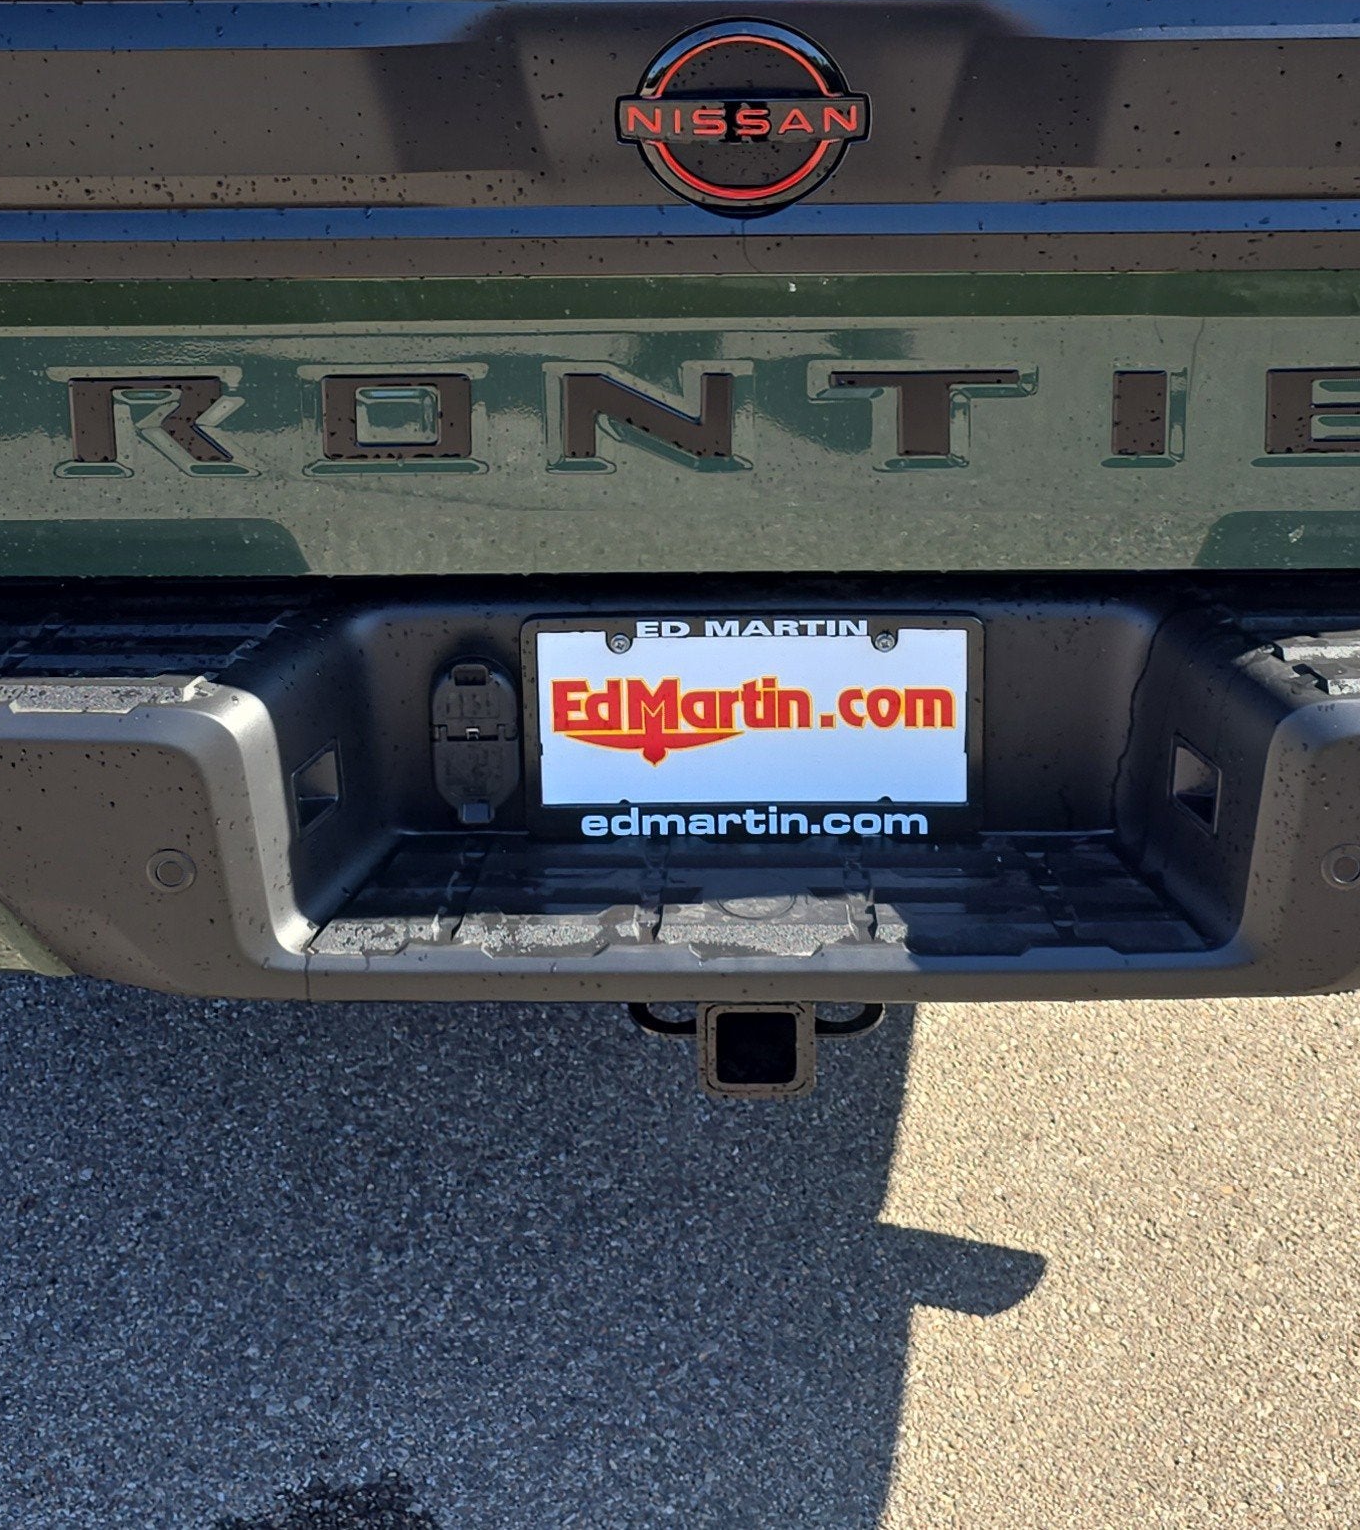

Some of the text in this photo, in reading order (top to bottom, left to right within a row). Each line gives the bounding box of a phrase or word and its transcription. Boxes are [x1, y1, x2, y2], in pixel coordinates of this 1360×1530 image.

[626, 105, 857, 136] NISSAN
[636, 619, 869, 639] ED MARTIN
[550, 676, 957, 733] EdMartin.com
[580, 806, 929, 837] edmartin.com
